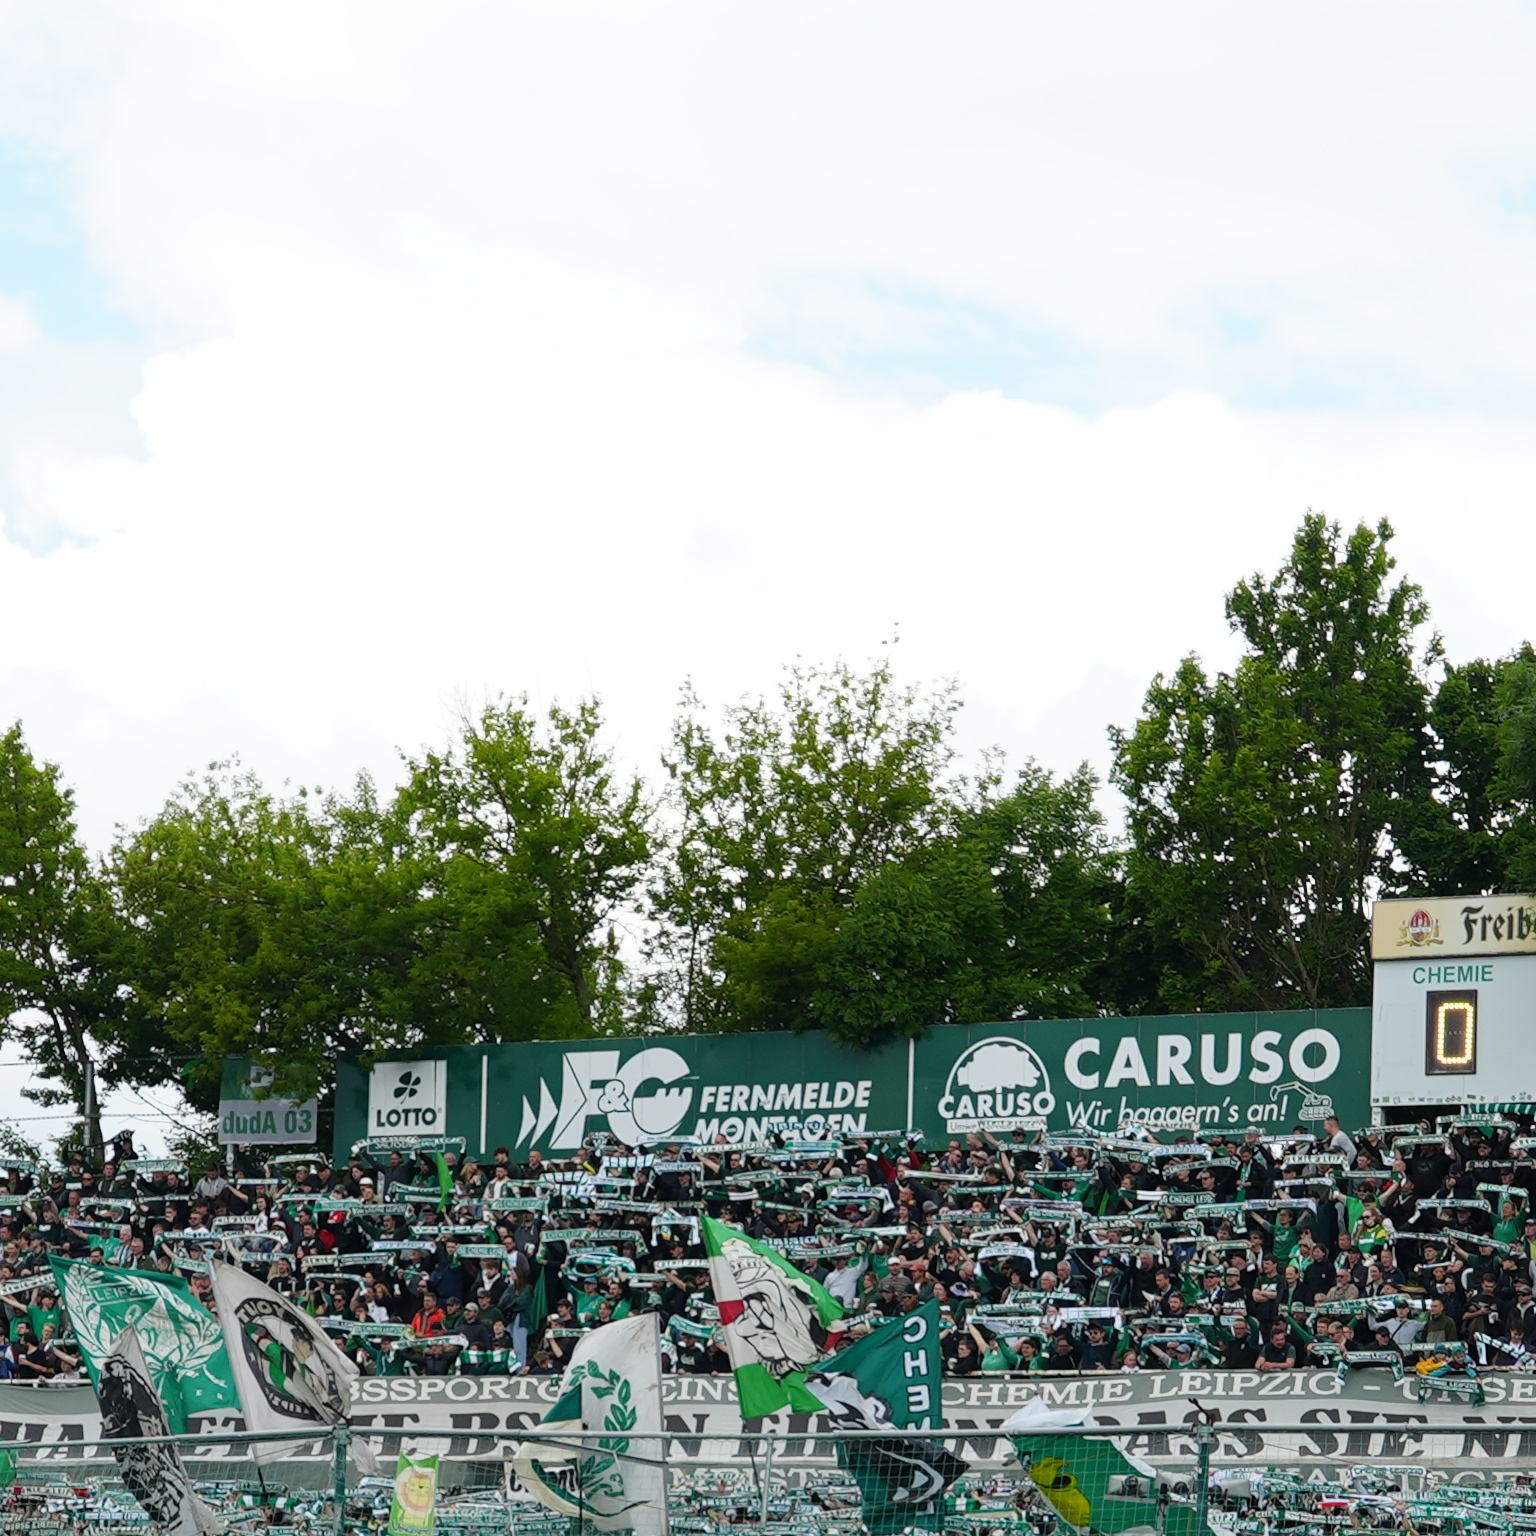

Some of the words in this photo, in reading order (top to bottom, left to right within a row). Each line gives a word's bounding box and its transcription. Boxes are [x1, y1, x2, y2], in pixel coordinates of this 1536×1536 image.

[1412, 965, 1493, 984] CHEMIE
[1437, 1002, 1475, 1065] 0
[1065, 1028, 1341, 1089] CARUSO
[700, 1080, 872, 1113] FERNMELDE
[938, 1091, 1056, 1119] CARUSO
[1066, 1097, 1107, 1125] Wir
[1244, 1095, 1286, 1122] an!
[284, 1109, 313, 1135] 03
[376, 1107, 438, 1129] LOTTO
[695, 1113, 867, 1147] MONTAGEN
[941, 1373, 1136, 1405] CHEMIE
[1164, 1368, 1342, 1398] LEIPZIG
